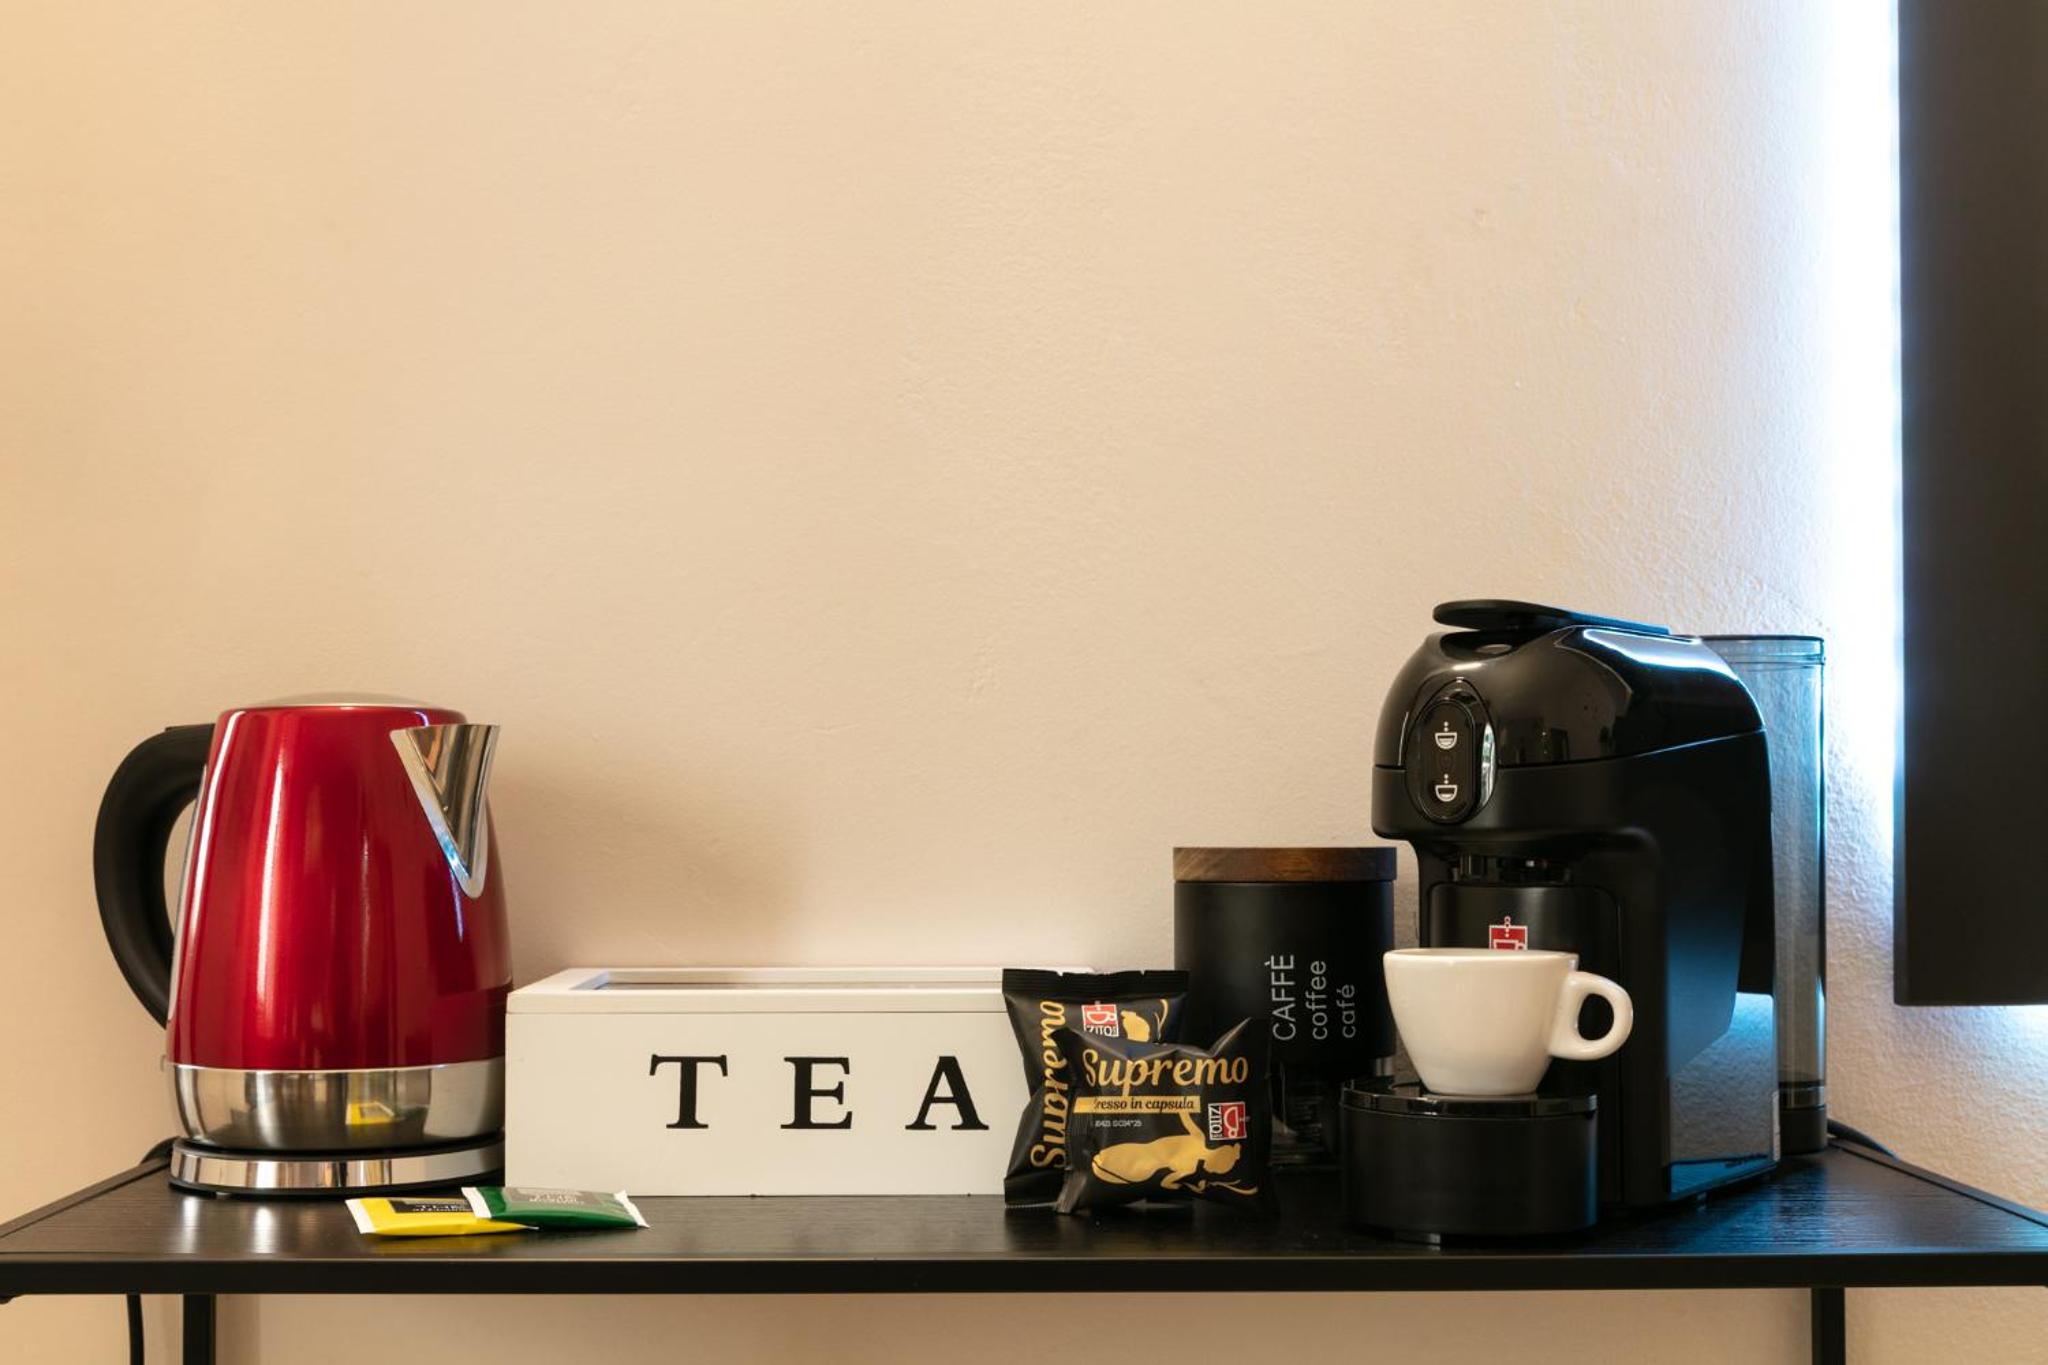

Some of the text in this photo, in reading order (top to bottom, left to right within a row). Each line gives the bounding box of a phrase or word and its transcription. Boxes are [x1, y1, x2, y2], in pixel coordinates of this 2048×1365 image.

[1264, 955, 1296, 1041] CAFFÈ
[1306, 960, 1328, 1040] coffee
[1336, 984, 1355, 1039] café
[649, 1054, 990, 1131] TEA
[1083, 1049, 1249, 1097] Supremo
[1093, 1096, 1194, 1112] resso in capsula
